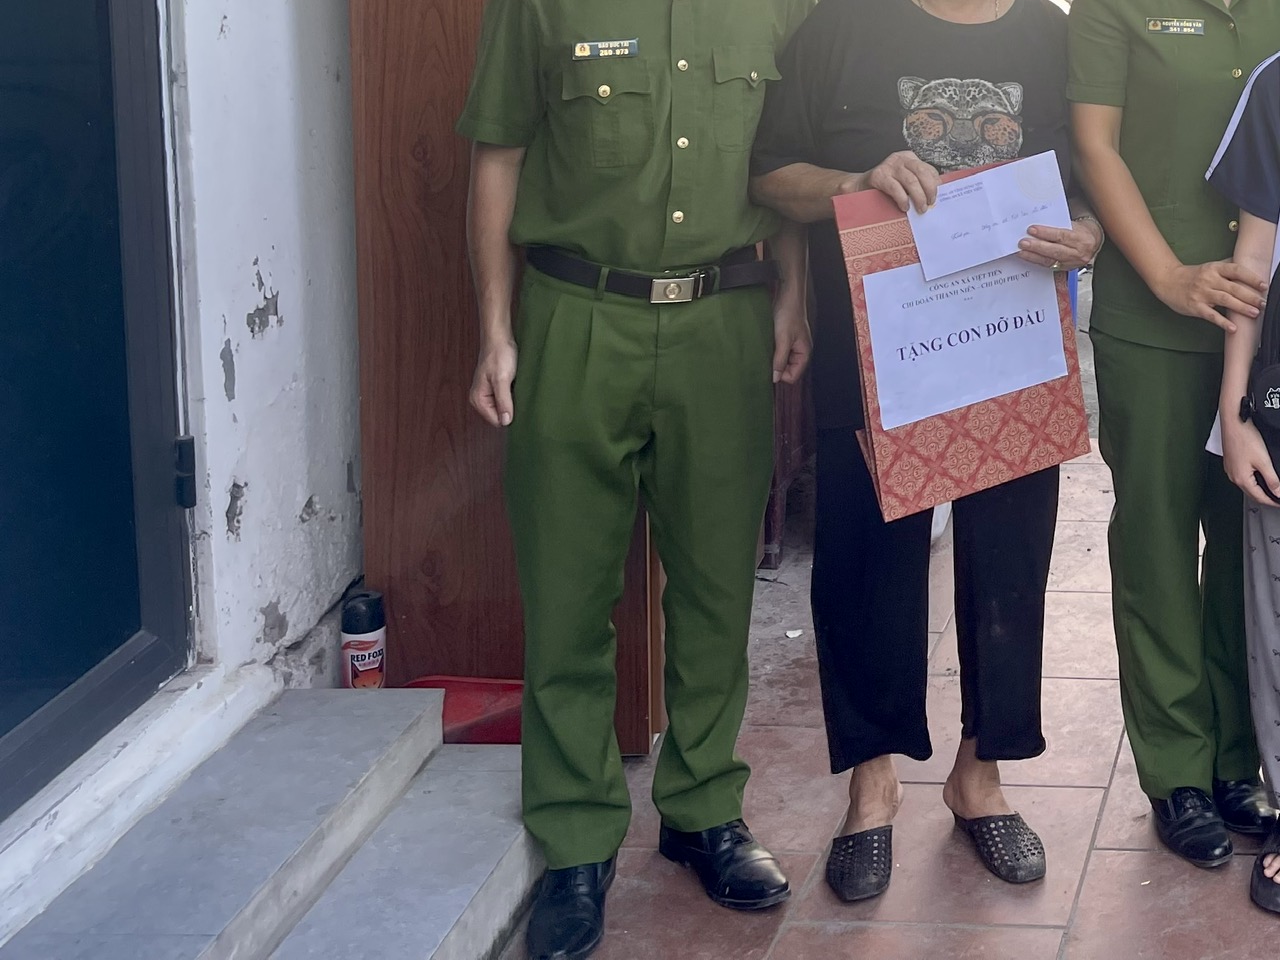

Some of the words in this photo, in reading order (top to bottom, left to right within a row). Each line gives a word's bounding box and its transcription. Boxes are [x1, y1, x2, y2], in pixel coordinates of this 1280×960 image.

[896, 337, 943, 361] TẶNG
[946, 325, 982, 347] CON
[985, 316, 1009, 338] ĐỠ
[350, 654, 367, 662] RED
